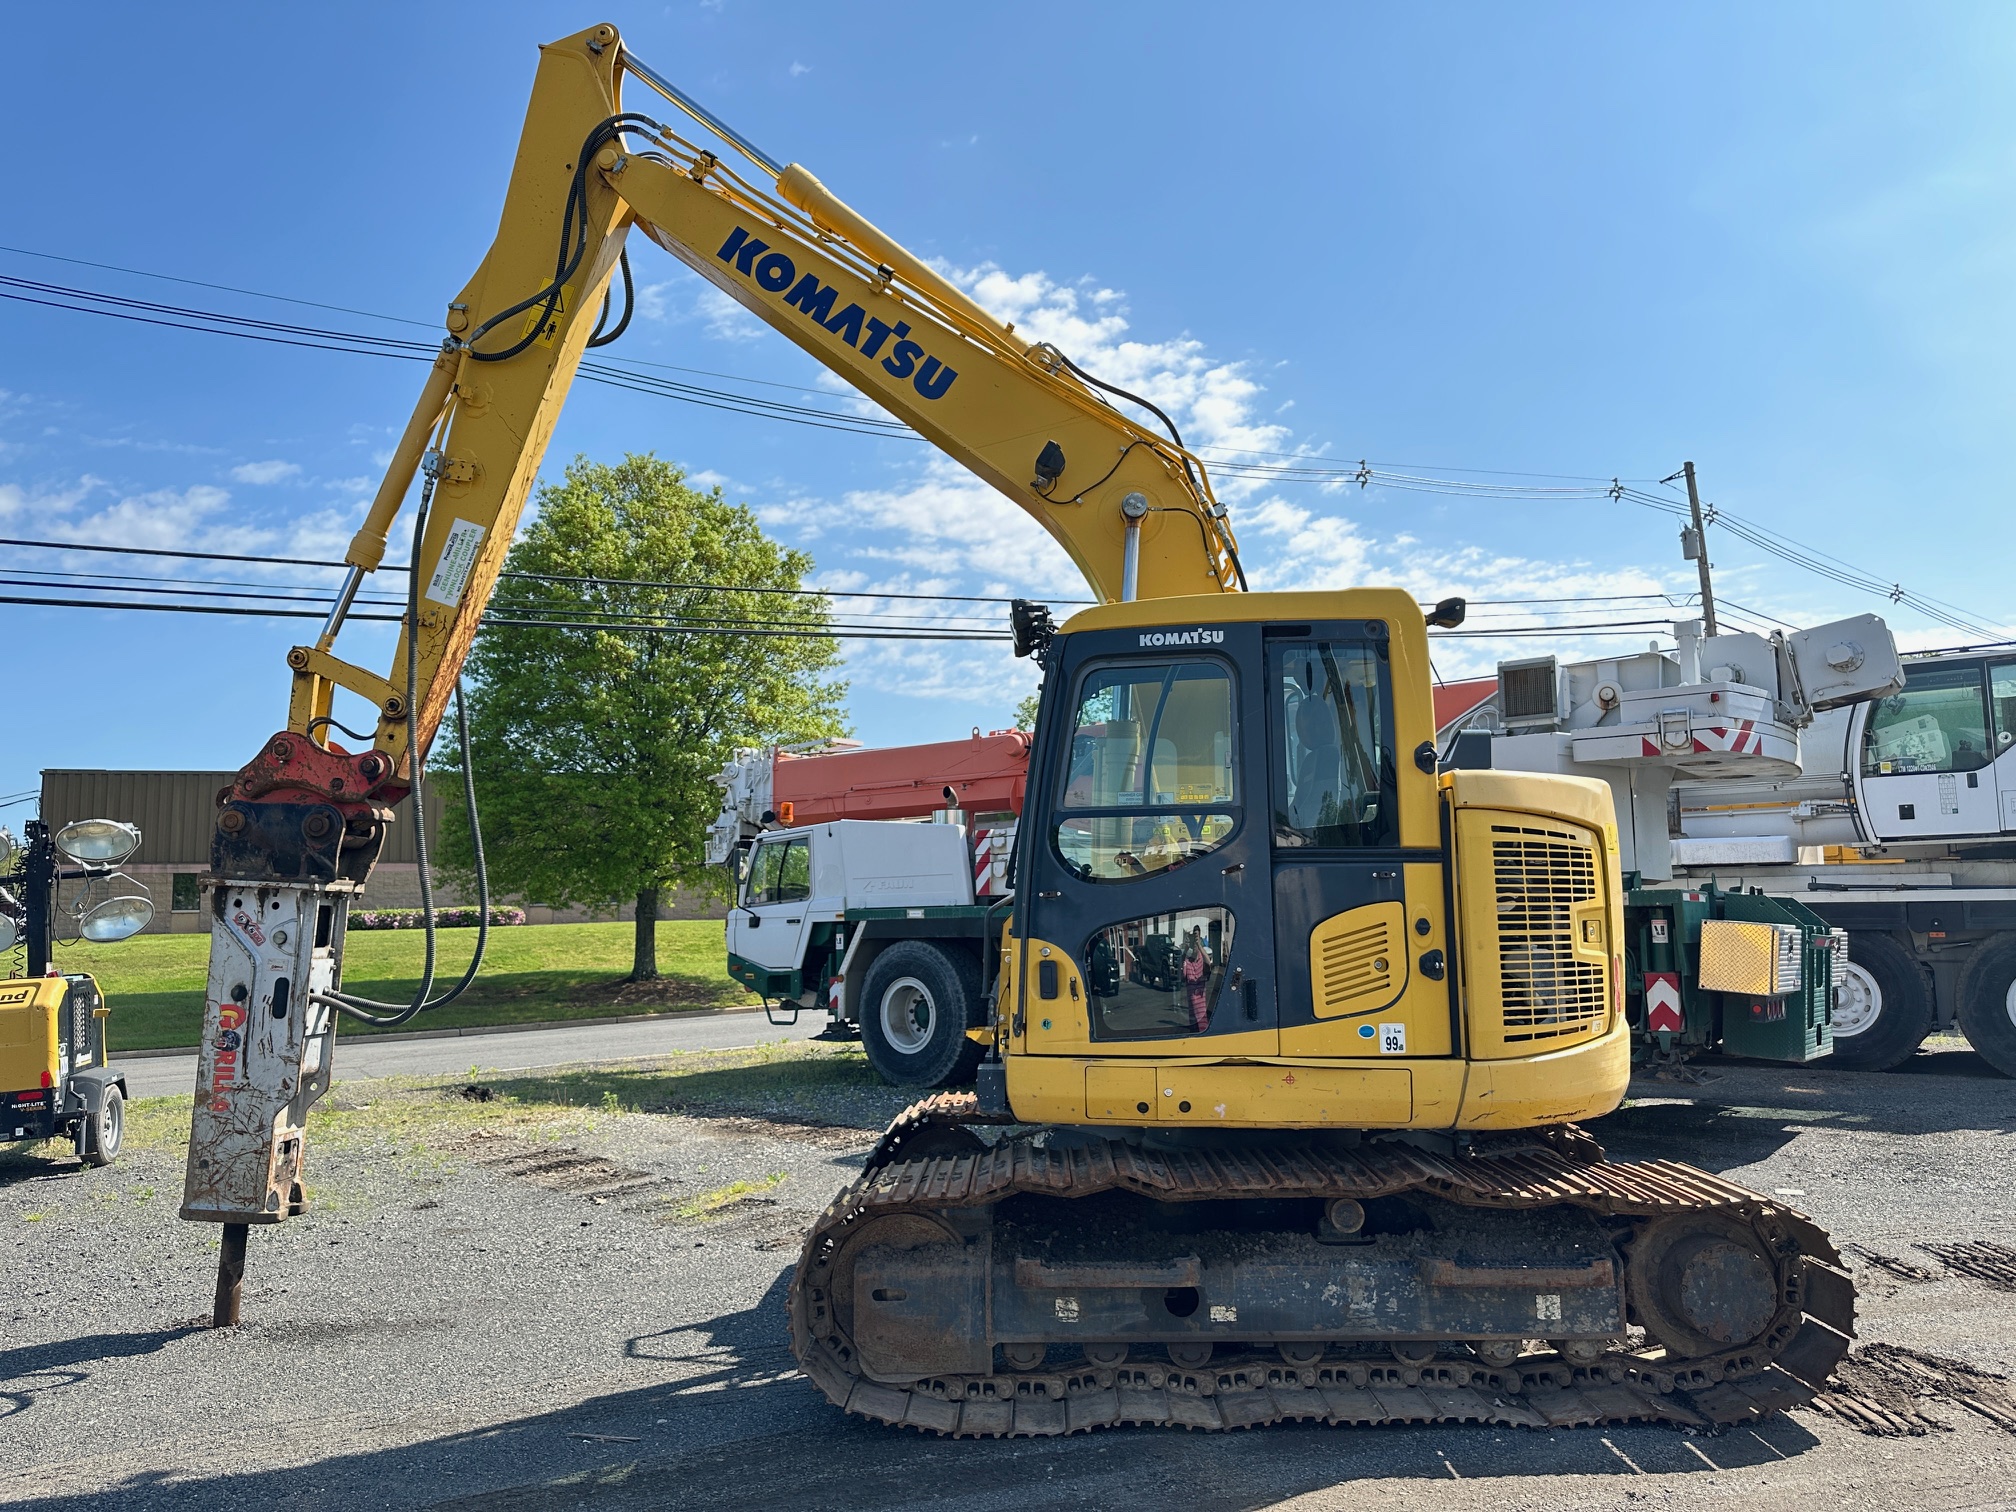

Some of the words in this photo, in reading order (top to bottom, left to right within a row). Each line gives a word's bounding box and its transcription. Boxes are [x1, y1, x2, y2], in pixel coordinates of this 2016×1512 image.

[716, 226, 959, 400] KOMATSU
[440, 559, 457, 592] GENUINE
[444, 562, 464, 600] TWINLOCK
[460, 528, 478, 562] COUPLER
[1139, 627, 1224, 647] KOMATSU
[1385, 1036, 1398, 1051] 99
